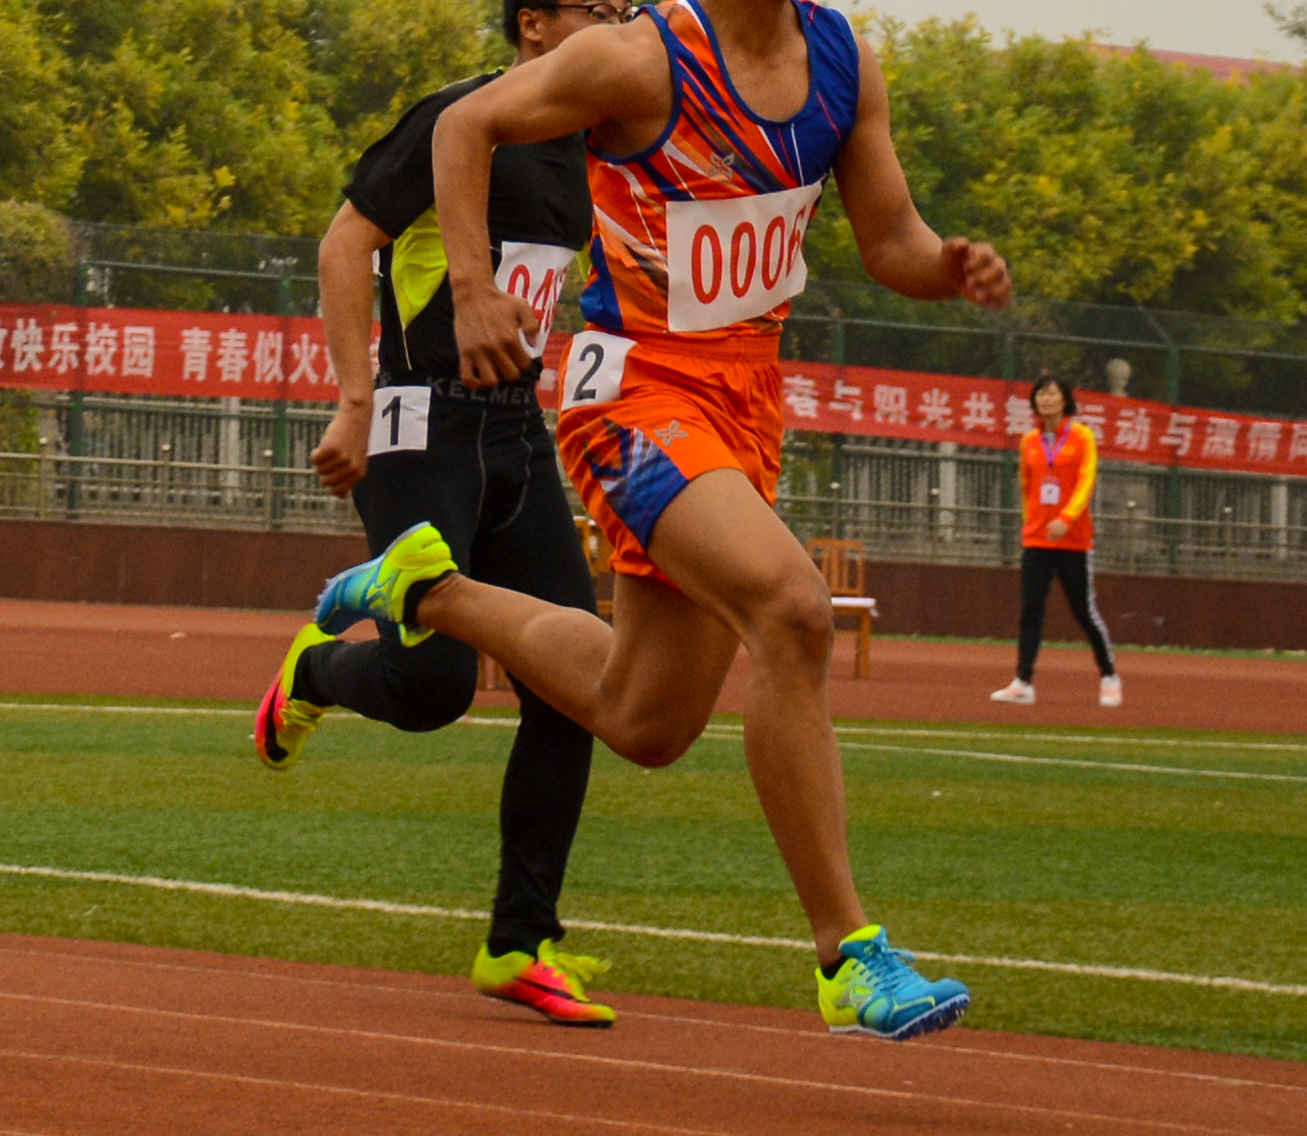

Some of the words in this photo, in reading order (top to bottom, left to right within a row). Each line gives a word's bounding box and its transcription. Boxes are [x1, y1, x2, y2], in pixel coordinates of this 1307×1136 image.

[179, 326, 339, 386] 青春似火
[571, 342, 605, 401] 2
[381, 395, 402, 446] 1
